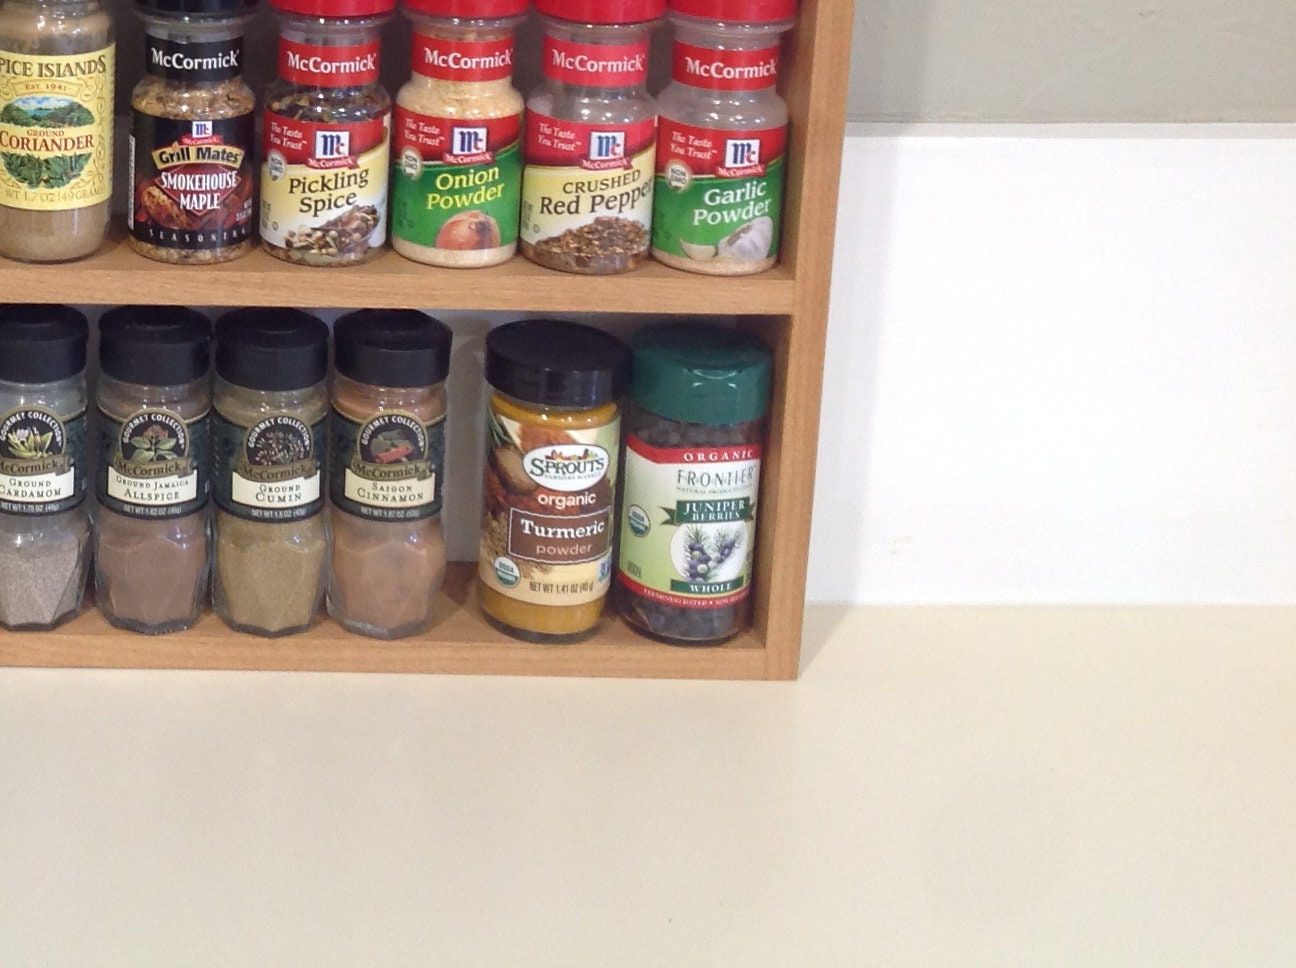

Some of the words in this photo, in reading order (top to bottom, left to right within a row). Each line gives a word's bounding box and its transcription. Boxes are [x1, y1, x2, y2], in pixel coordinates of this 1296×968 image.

[37, 55, 106, 78] ISLANDS
[151, 47, 238, 70] McCormick
[287, 51, 373, 73] McCormick
[424, 48, 511, 69] McCormick
[552, 49, 642, 73] McCormick
[685, 57, 775, 78] McCormick
[27, 129, 65, 137] GROUND
[418, 122, 440, 134] Taste
[554, 127, 575, 139] Taste
[418, 133, 439, 147] Trust
[553, 138, 575, 151] Trust
[690, 134, 713, 148] Taste
[159, 148, 191, 163] Grill
[197, 147, 240, 162] Mates
[687, 146, 712, 160] Trust
[161, 171, 238, 191] SMOKEHOUSE
[289, 168, 368, 194] Pickling
[436, 167, 499, 190] Onion
[563, 169, 641, 194] CRUSHED
[179, 194, 221, 210] MAPLE
[427, 182, 505, 210] Powder
[540, 196, 579, 215] Red
[590, 178, 653, 214] Pepper
[704, 181, 766, 207] Garlic
[299, 193, 357, 217] Spice
[692, 198, 772, 225] Powder
[27, 412, 61, 444] COLLECTION
[123, 415, 149, 443] GOURMET
[151, 414, 184, 447] COLLECTION
[248, 418, 275, 448] GOURMET
[277, 417, 308, 448] COLLECTION
[391, 416, 424, 448] COLLECTION
[683, 449, 753, 462] ORGANIC
[530, 457, 605, 478] SPROUTS
[678, 466, 753, 485] FRONTIER
[9, 478, 51, 488] GROUND
[116, 475, 150, 488] GROUND
[154, 480, 189, 491] JAMAICA
[259, 484, 300, 493] GROUND
[373, 482, 412, 492] SAIGON
[124, 488, 179, 500] ALLSPICE
[255, 492, 302, 503] CUMIN
[357, 488, 423, 502] CINNAMON
[538, 492, 596, 510] organic
[685, 500, 746, 514] JUNIPER
[692, 511, 740, 521] BERRIES
[521, 520, 605, 539] Turmeric
[536, 543, 592, 556] powder
[689, 583, 732, 594] WHOLE
